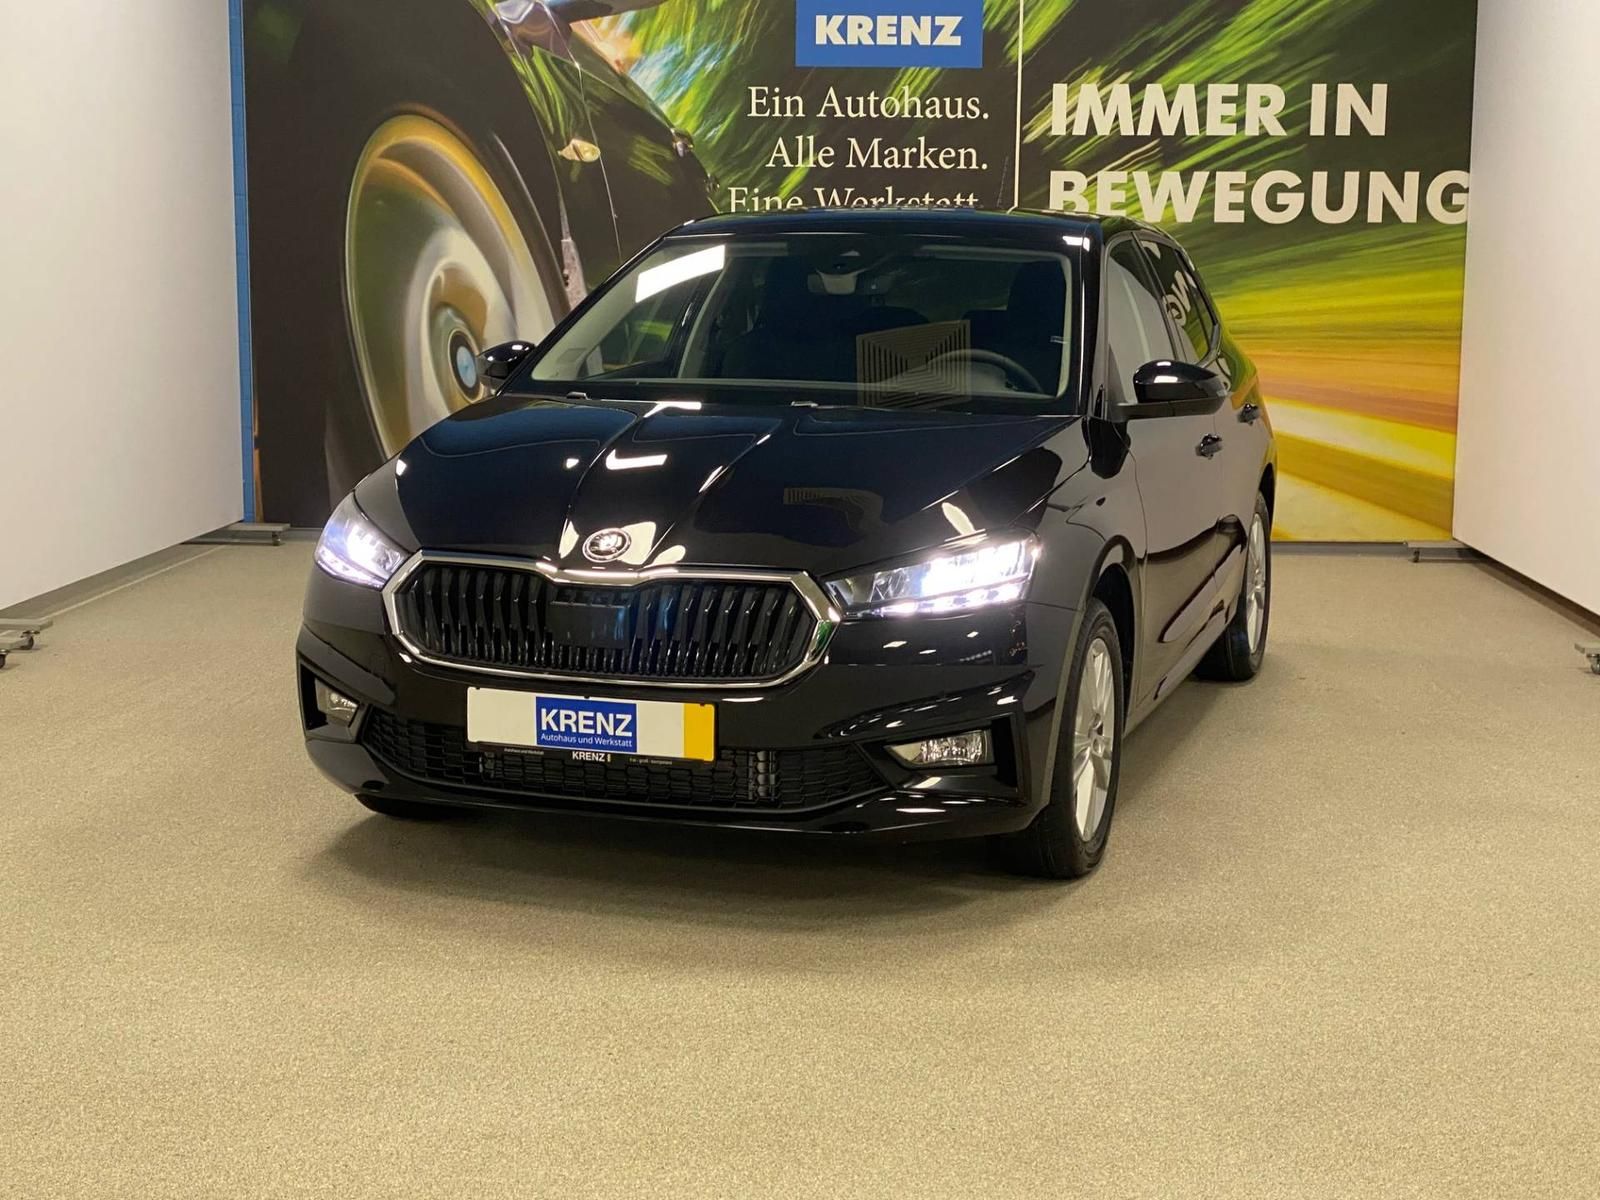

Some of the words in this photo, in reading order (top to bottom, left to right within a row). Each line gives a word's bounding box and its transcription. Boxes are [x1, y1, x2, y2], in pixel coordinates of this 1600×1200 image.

[815, 14, 963, 46] KRENZ
[747, 86, 805, 118] Ein
[816, 86, 989, 120] Autohaus.
[1050, 83, 1287, 136] IMMER
[1309, 83, 1388, 136] IN
[765, 135, 835, 169] Alle
[846, 135, 988, 170] Marken.
[1049, 169, 1470, 225] BEWEGUNG
[541, 708, 633, 737] KRENZ
[541, 733, 577, 744] Autohaus
[578, 735, 593, 745] und
[594, 737, 633, 748] Werkstatt
[572, 751, 606, 762] KRENZ
